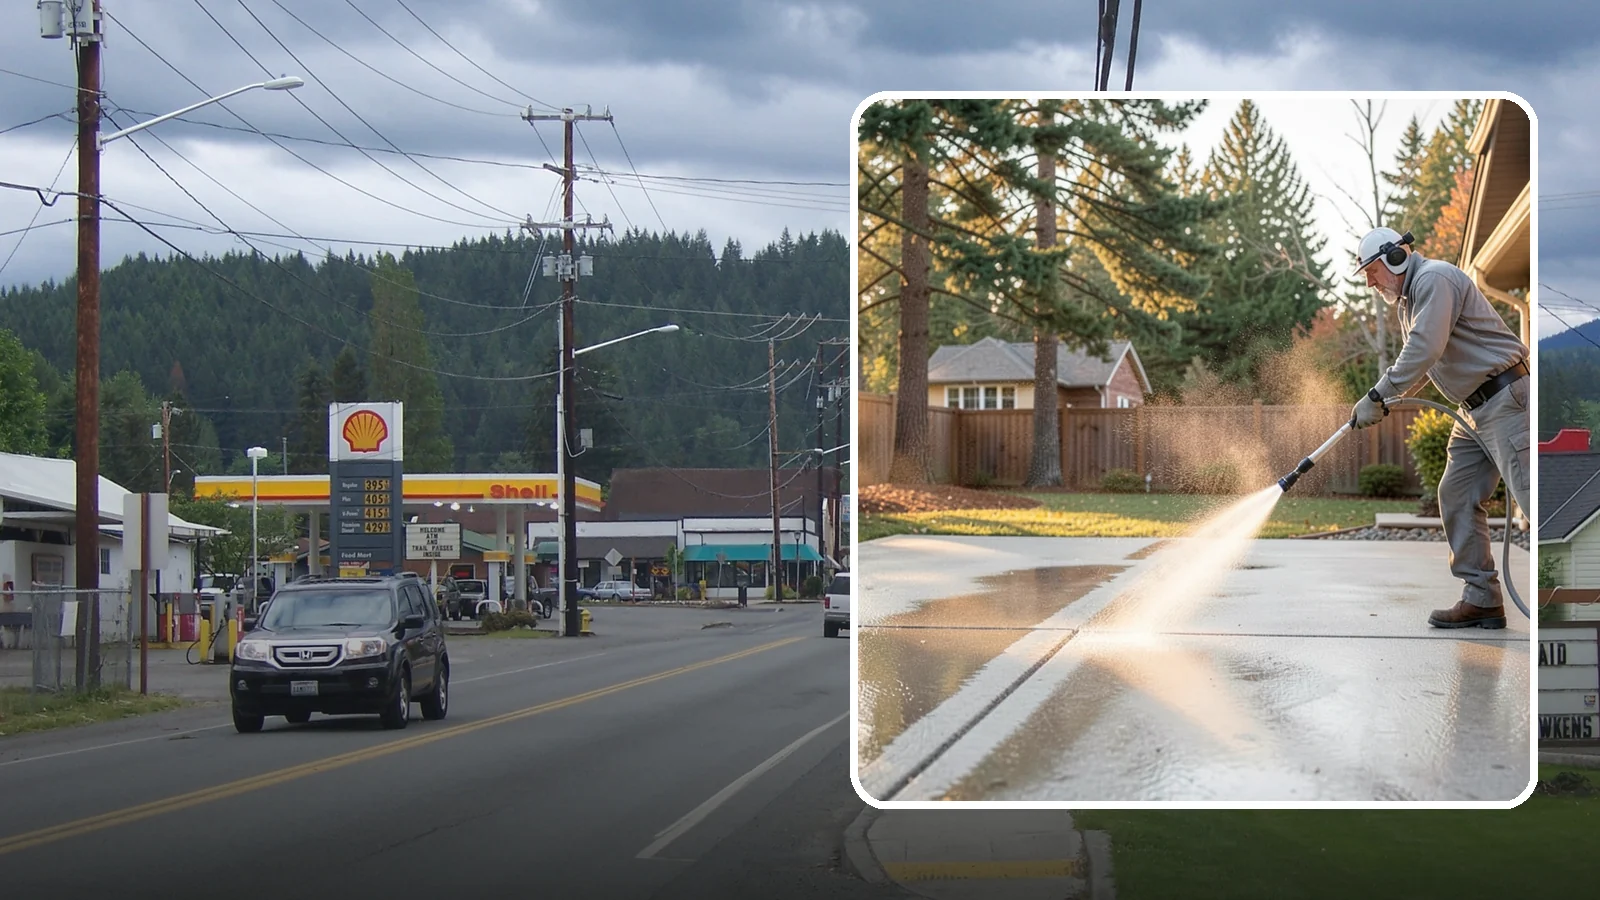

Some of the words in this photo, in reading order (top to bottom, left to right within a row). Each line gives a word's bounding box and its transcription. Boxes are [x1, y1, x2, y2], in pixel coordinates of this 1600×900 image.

[366, 480, 383, 490] 395
[490, 484, 547, 499] Shell
[366, 494, 383, 504] 405
[366, 508, 383, 518] 415
[366, 522, 383, 532] 429
